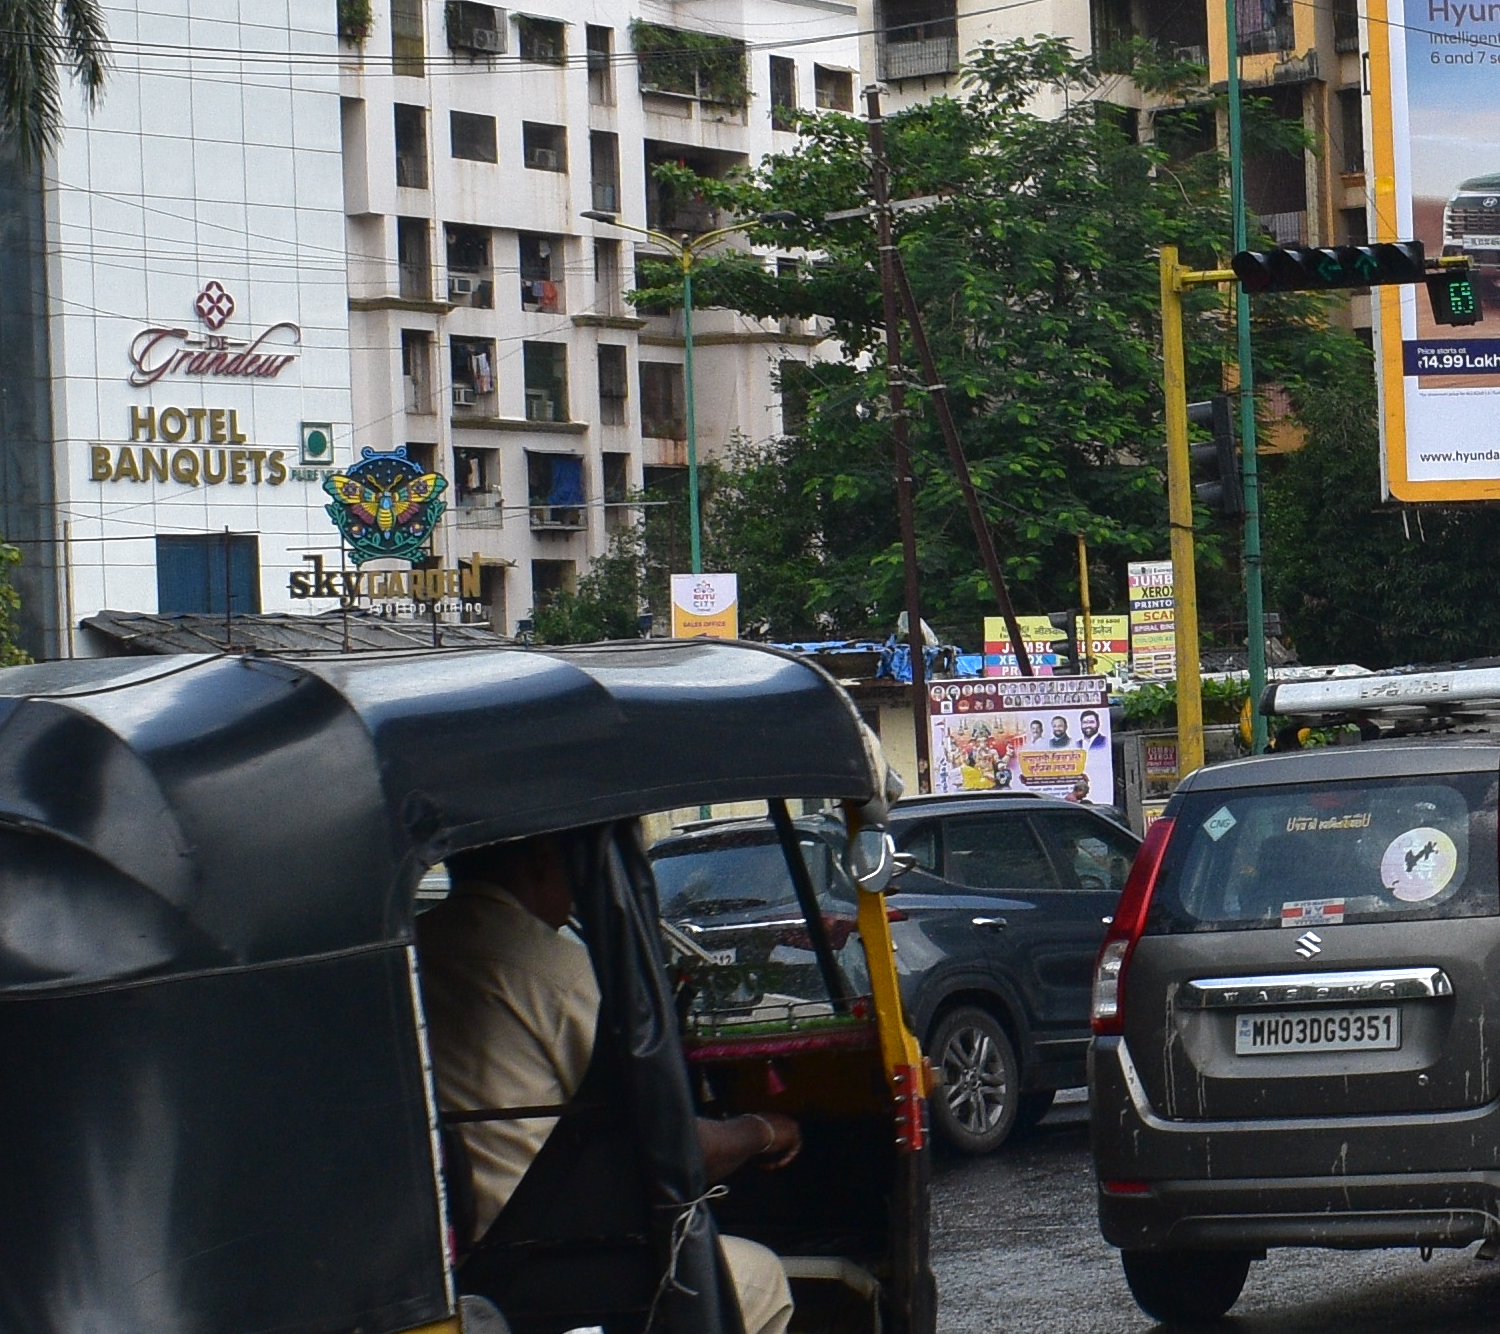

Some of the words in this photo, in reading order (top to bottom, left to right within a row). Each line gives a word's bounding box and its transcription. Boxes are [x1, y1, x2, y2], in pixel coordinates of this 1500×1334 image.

[1430, 51, 1441, 64] 6
[1444, 51, 1474, 64] and
[1477, 51, 1487, 64] 7
[206, 334, 229, 350] DE
[128, 322, 301, 388] Grandeur
[129, 406, 247, 444] HOTEL
[89, 446, 288, 487] BANQUETS
[1132, 575, 1174, 587] JUMB
[1134, 599, 1175, 610] PRINTO
[999, 655, 1043, 665] XEOX
[1002, 666, 1040, 676] PRT
[1209, 818, 1231, 829] CNG
[1252, 1015, 1392, 1047] MH03DG9351
